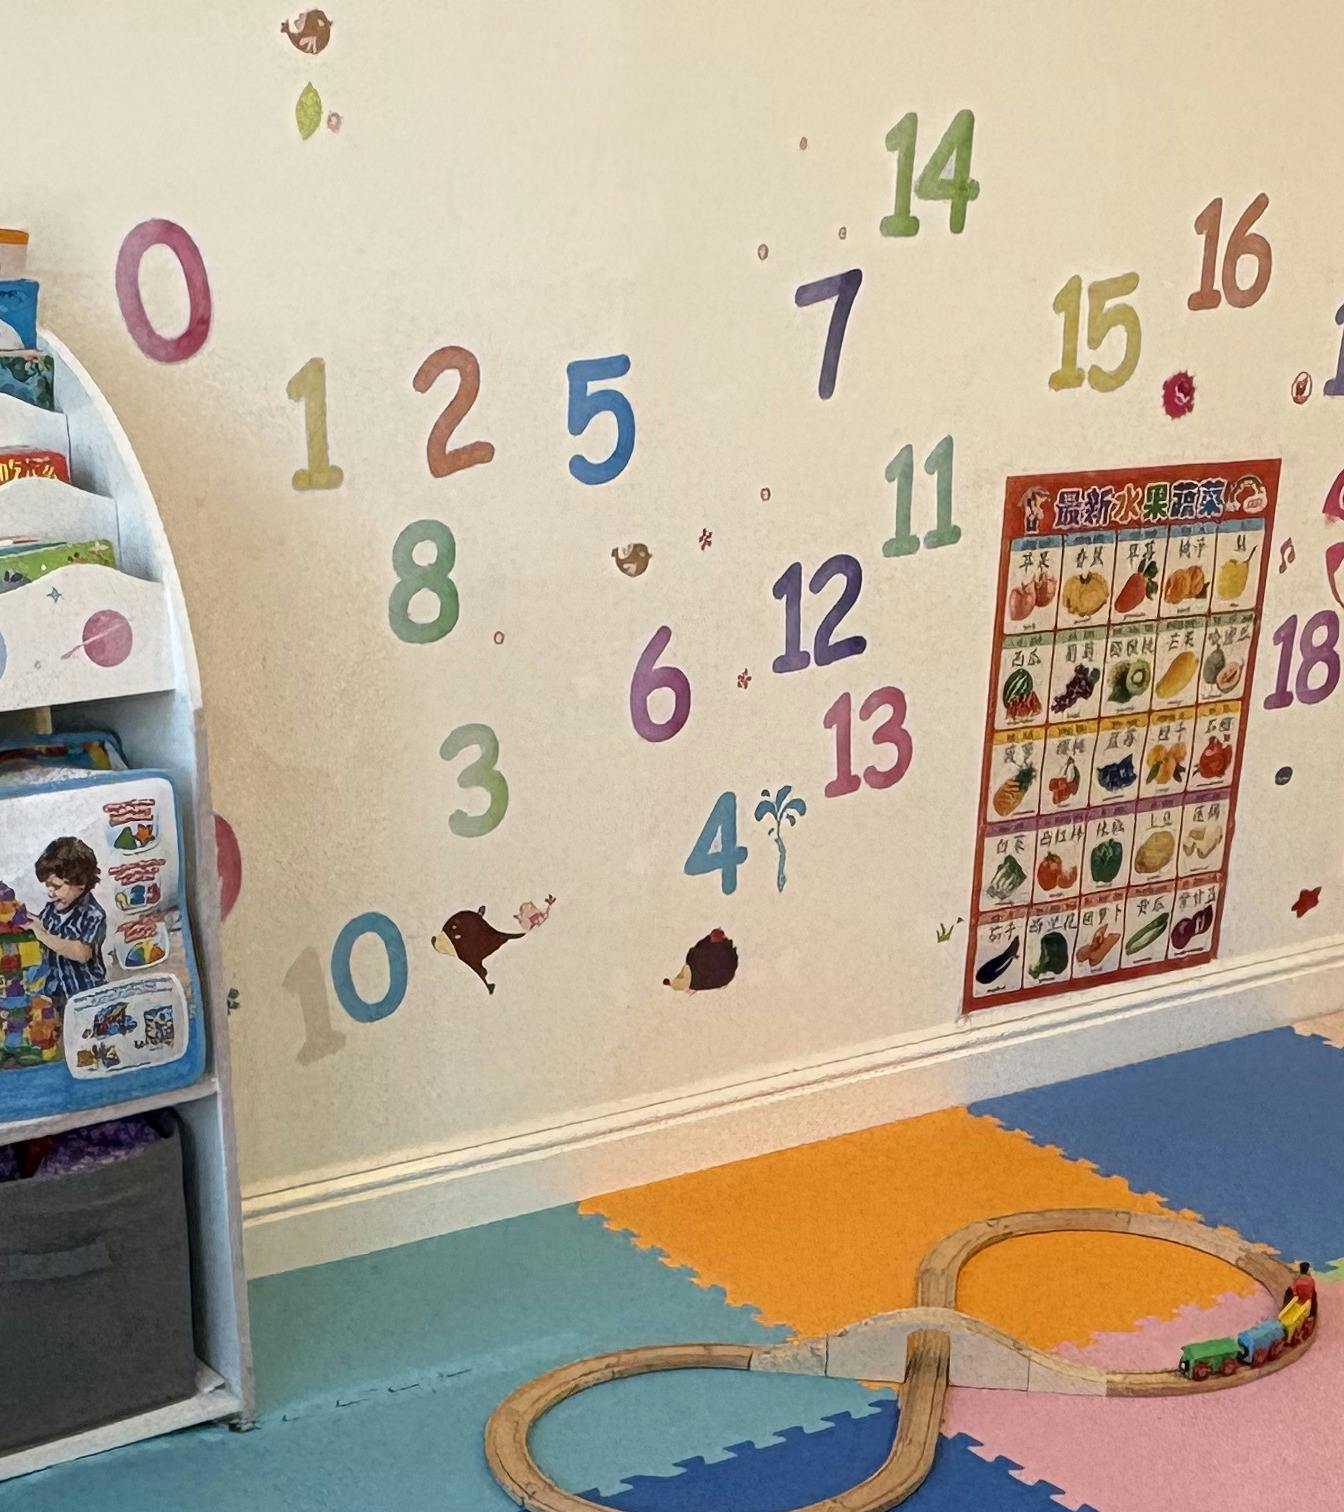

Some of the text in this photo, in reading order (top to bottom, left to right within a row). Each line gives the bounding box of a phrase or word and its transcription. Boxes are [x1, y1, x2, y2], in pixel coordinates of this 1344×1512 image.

[880, 109, 980, 237] 14
[115, 218, 211, 363] 0
[1187, 193, 1272, 310] 16
[795, 268, 862, 400] 7
[1049, 272, 1142, 393] 15
[287, 358, 343, 491] 1
[413, 346, 495, 478] 2
[567, 355, 635, 485] 5
[882, 434, 961, 557] 11
[389, 519, 459, 643] 8
[772, 554, 867, 673] 12
[631, 626, 691, 742] 6
[1263, 610, 1341, 710] 18
[440, 723, 509, 838] 3
[823, 686, 913, 798] 13
[684, 791, 748, 895] 4
